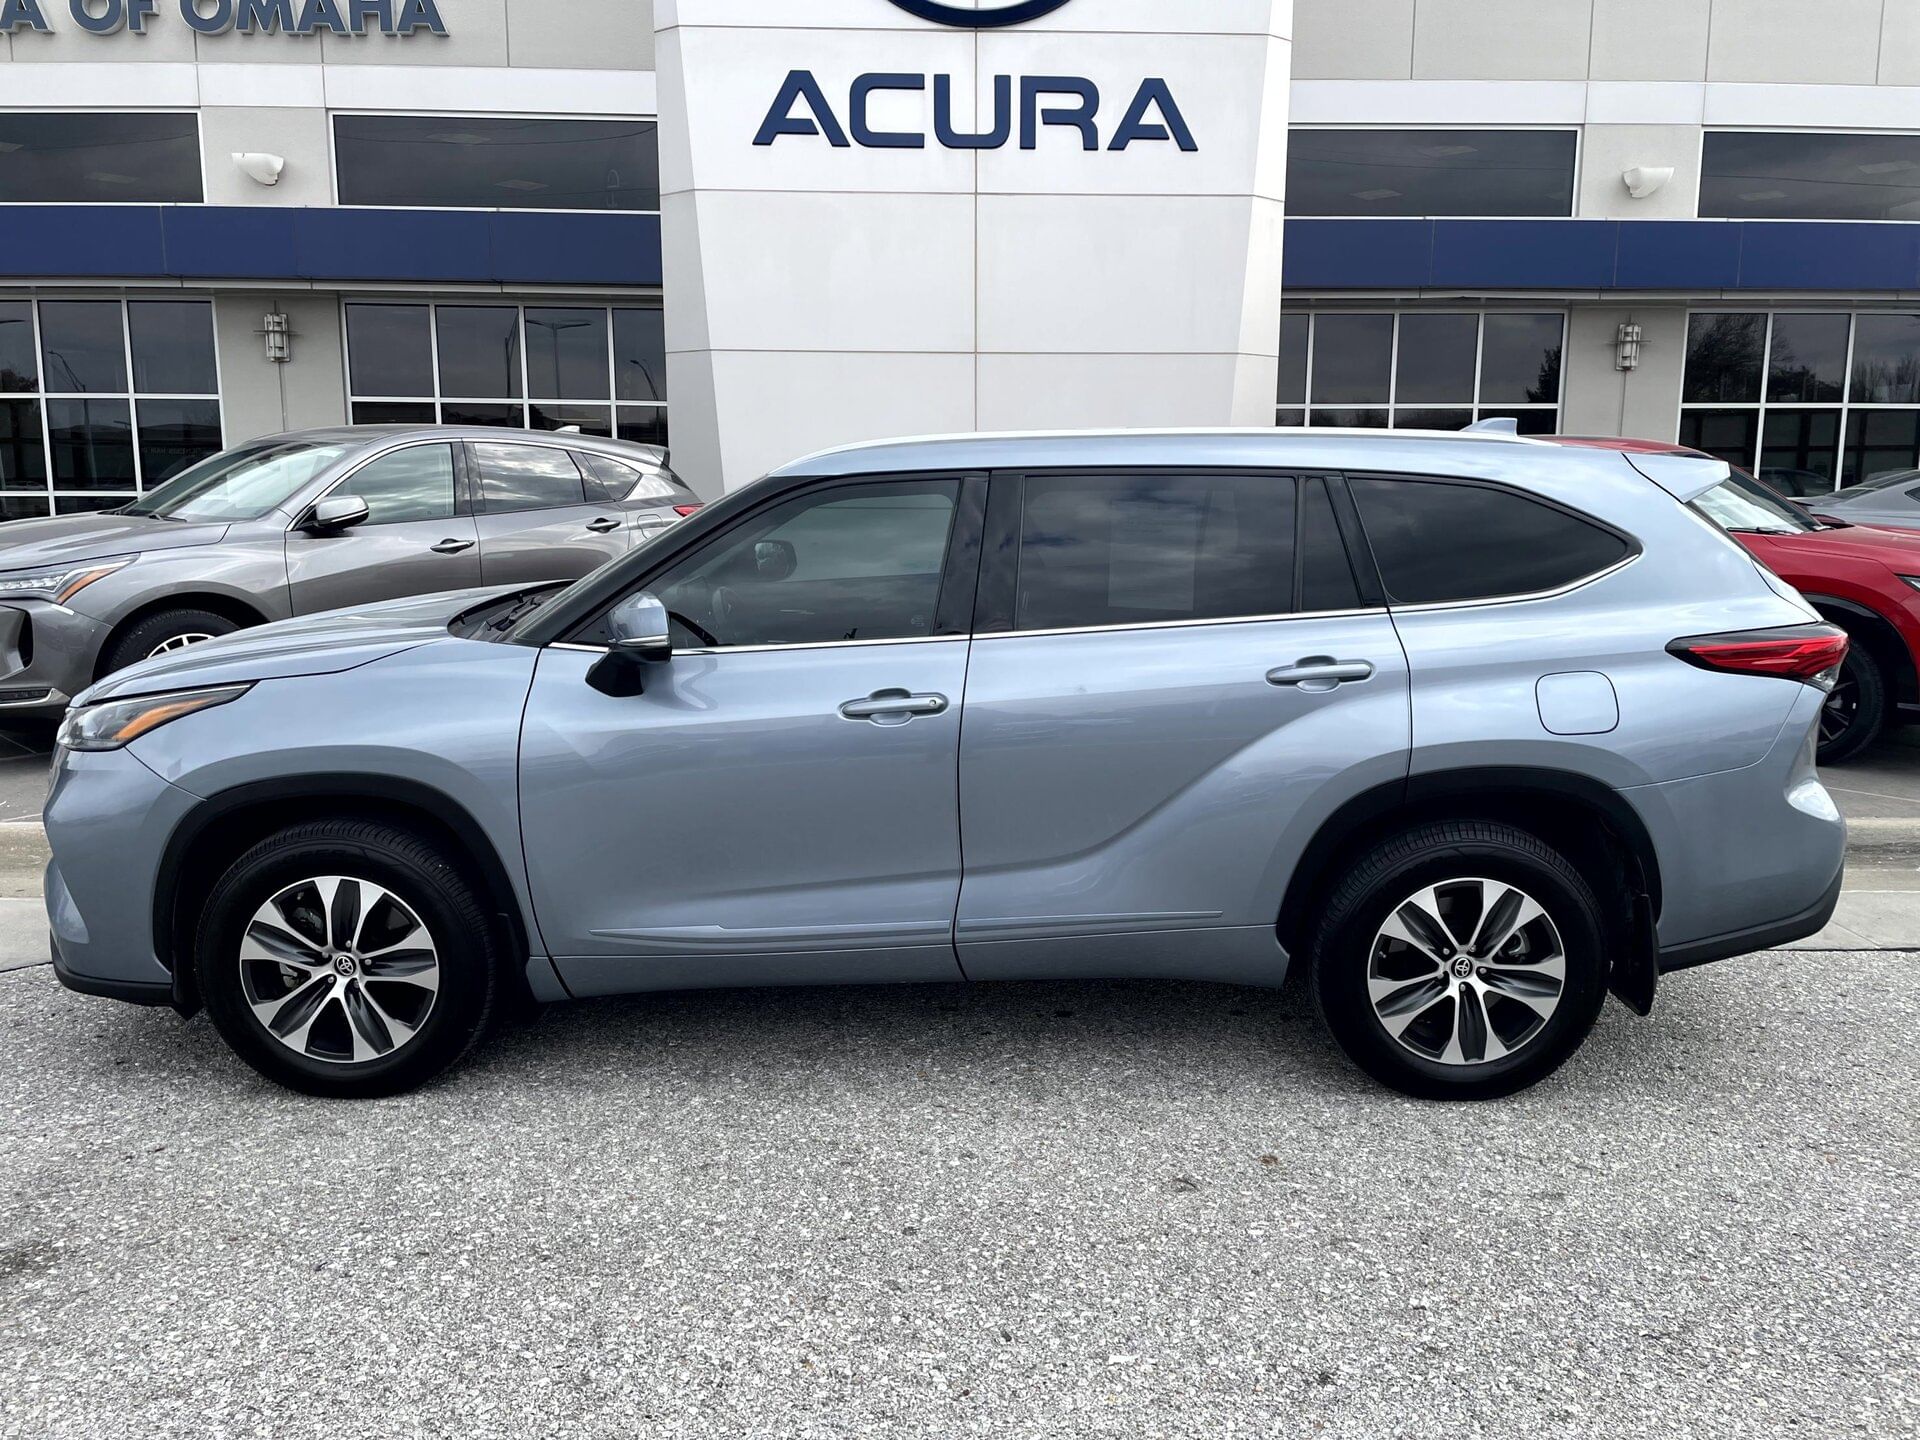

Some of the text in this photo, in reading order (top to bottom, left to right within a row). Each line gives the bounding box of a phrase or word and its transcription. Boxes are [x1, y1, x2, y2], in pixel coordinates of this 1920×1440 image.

[69, 0, 157, 35] OF
[180, 0, 449, 36] OMAHA
[752, 70, 1199, 151] ACURA
